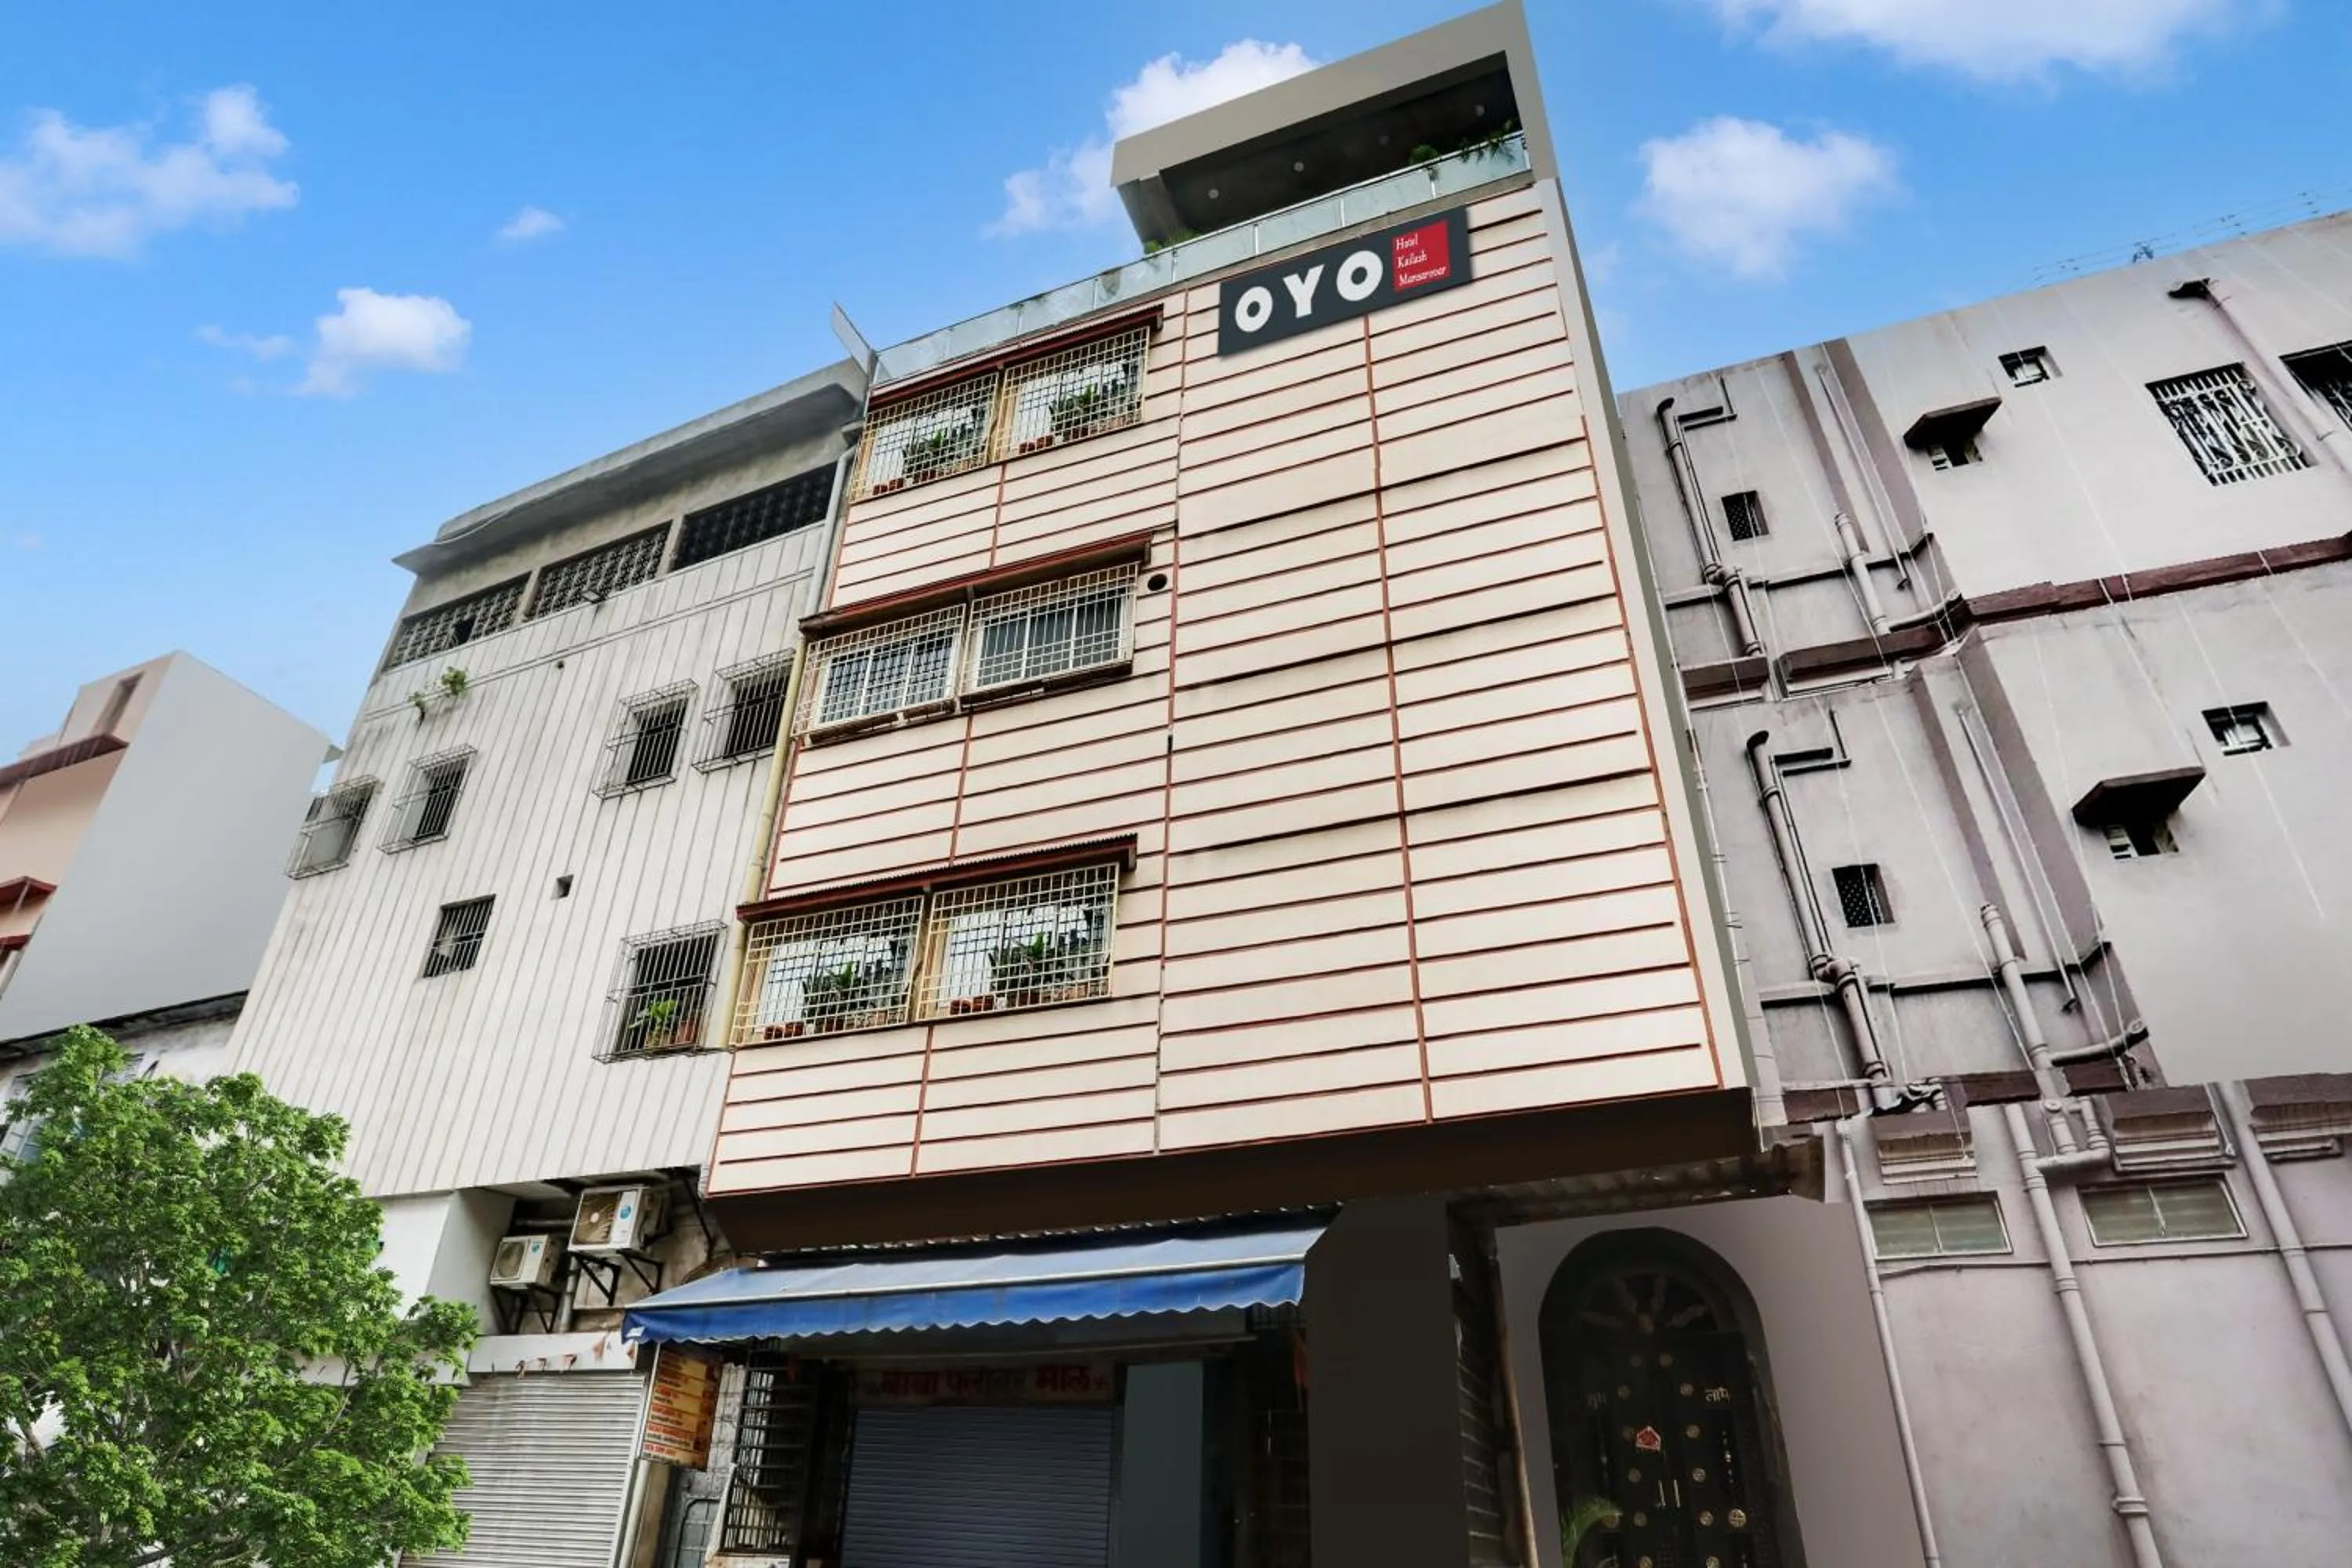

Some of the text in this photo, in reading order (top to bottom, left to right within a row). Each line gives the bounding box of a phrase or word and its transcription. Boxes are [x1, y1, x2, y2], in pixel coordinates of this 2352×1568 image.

[1396, 233, 1418, 251] Hotel
[1398, 250, 1427, 268] Kailash
[1236, 250, 1383, 332] OYO
